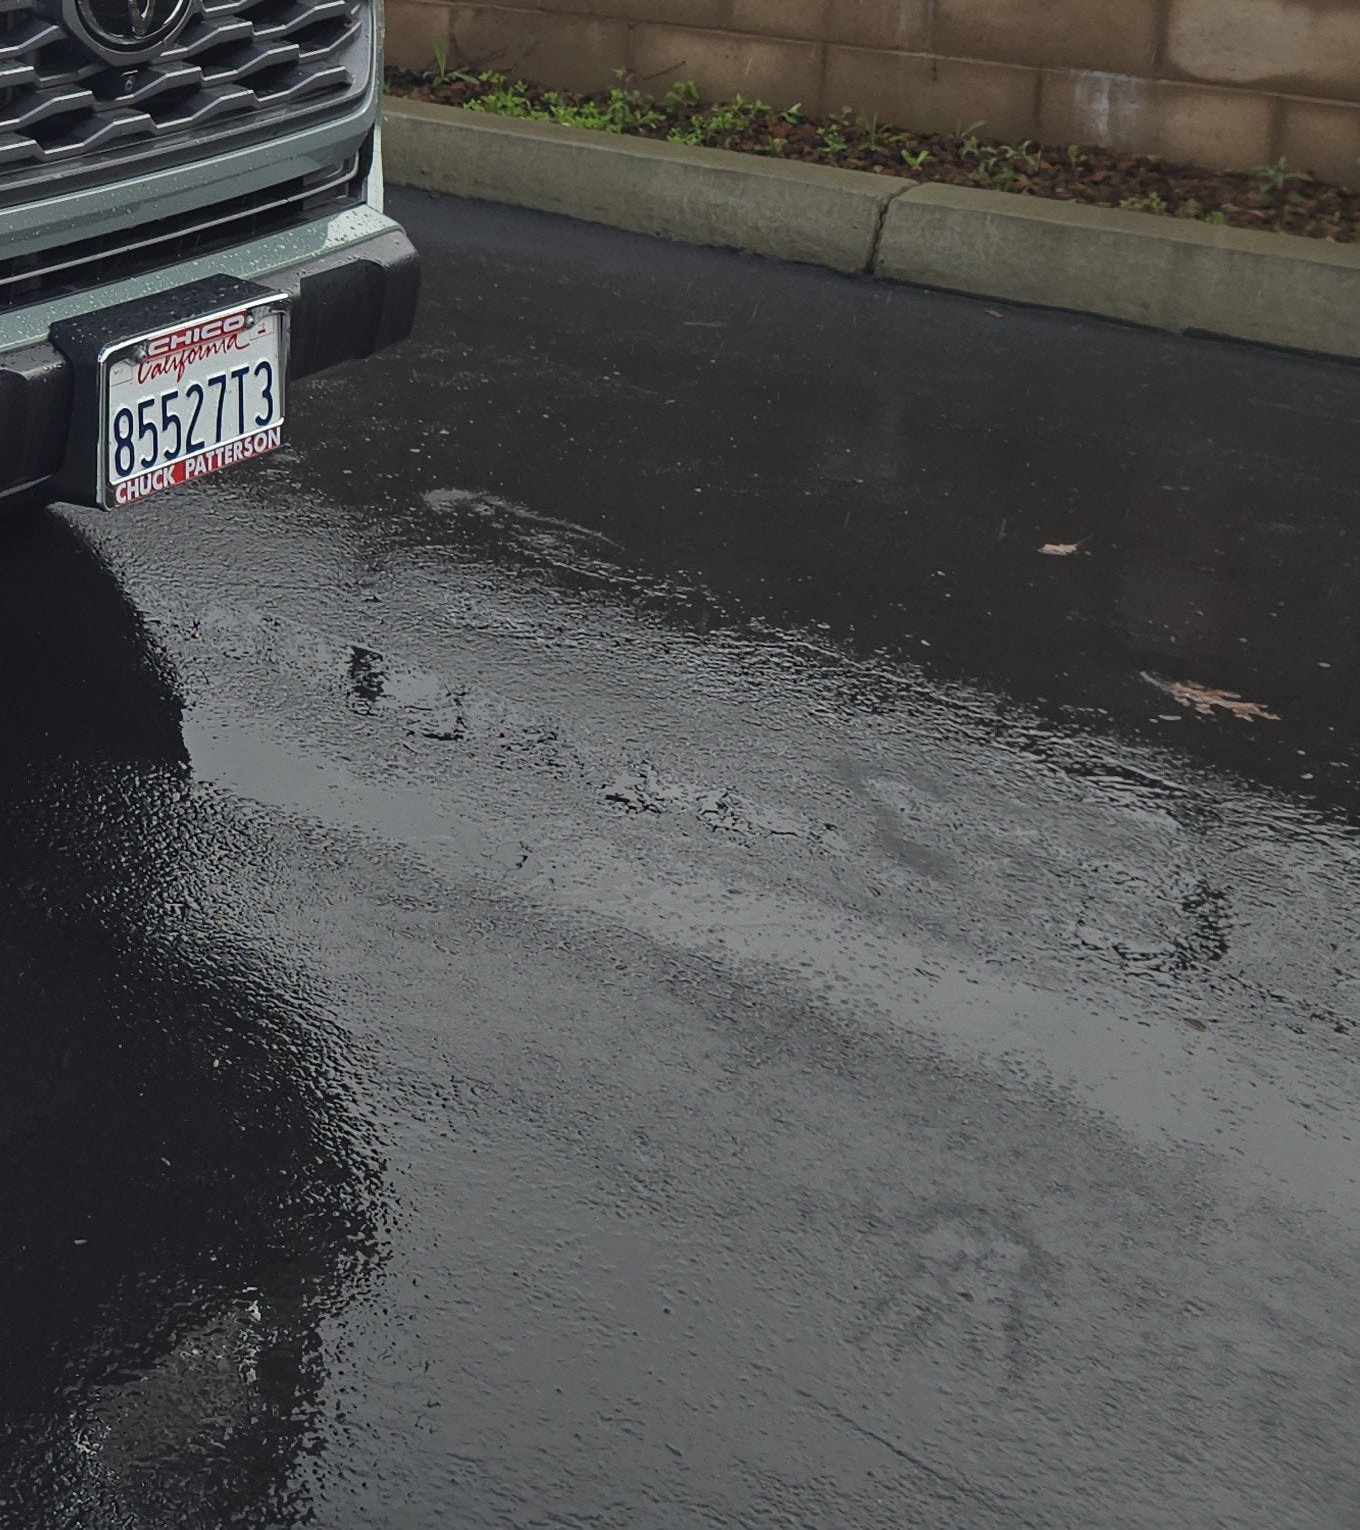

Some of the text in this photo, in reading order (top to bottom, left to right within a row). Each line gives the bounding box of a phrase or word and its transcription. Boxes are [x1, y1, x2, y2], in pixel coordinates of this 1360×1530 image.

[137, 333, 251, 385] California
[147, 314, 245, 357] CHICO
[113, 360, 274, 478] 85527T3
[115, 427, 281, 505] CHUCK PATTERSON
